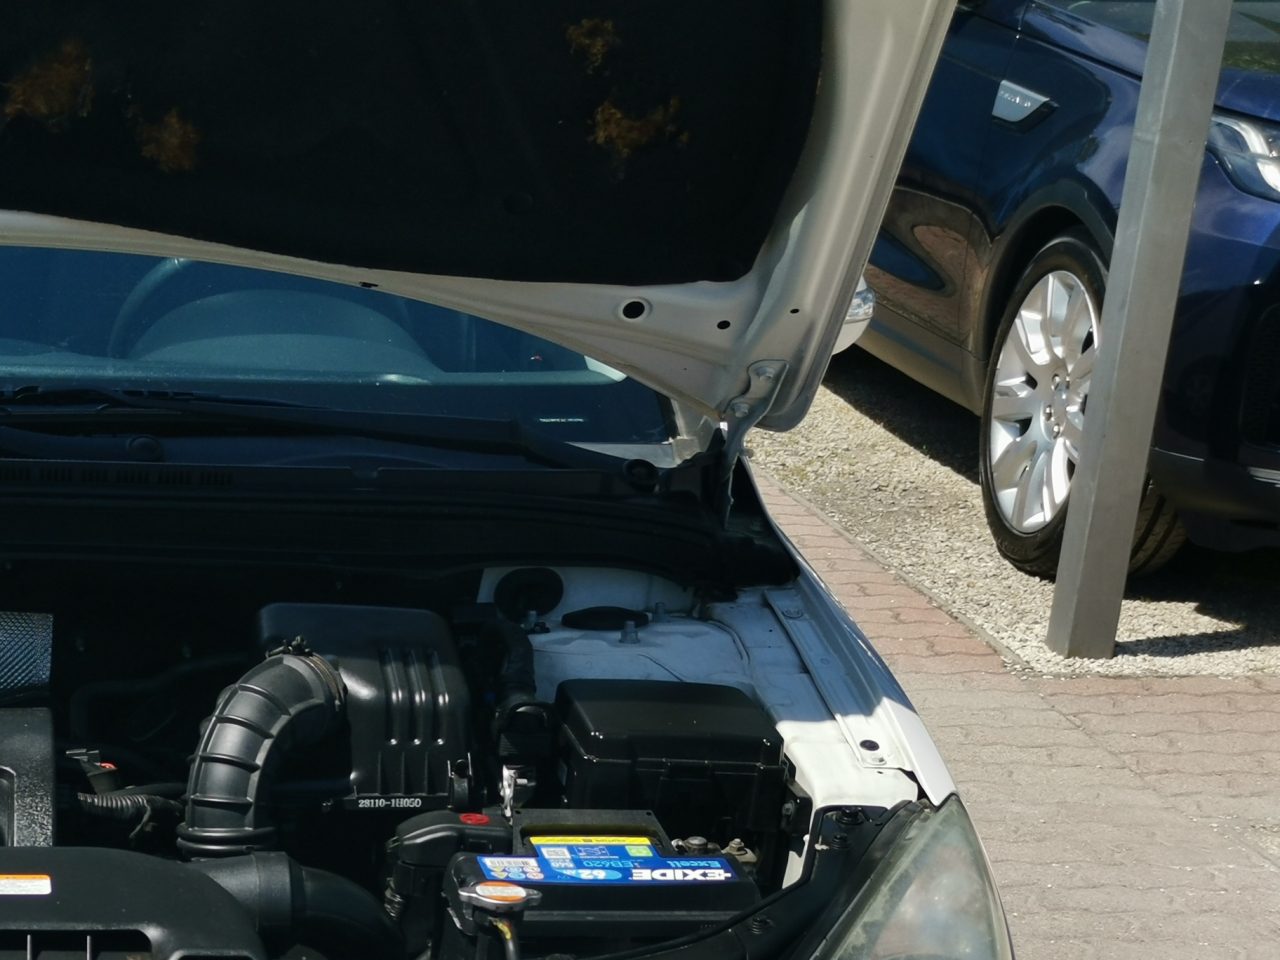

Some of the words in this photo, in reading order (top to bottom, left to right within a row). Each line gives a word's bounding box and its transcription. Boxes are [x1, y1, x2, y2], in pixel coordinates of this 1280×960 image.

[358, 798, 422, 808] 28110-1H050
[667, 860, 722, 868] Excell
[578, 868, 607, 880] 62
[631, 868, 733, 881] EXIDE
